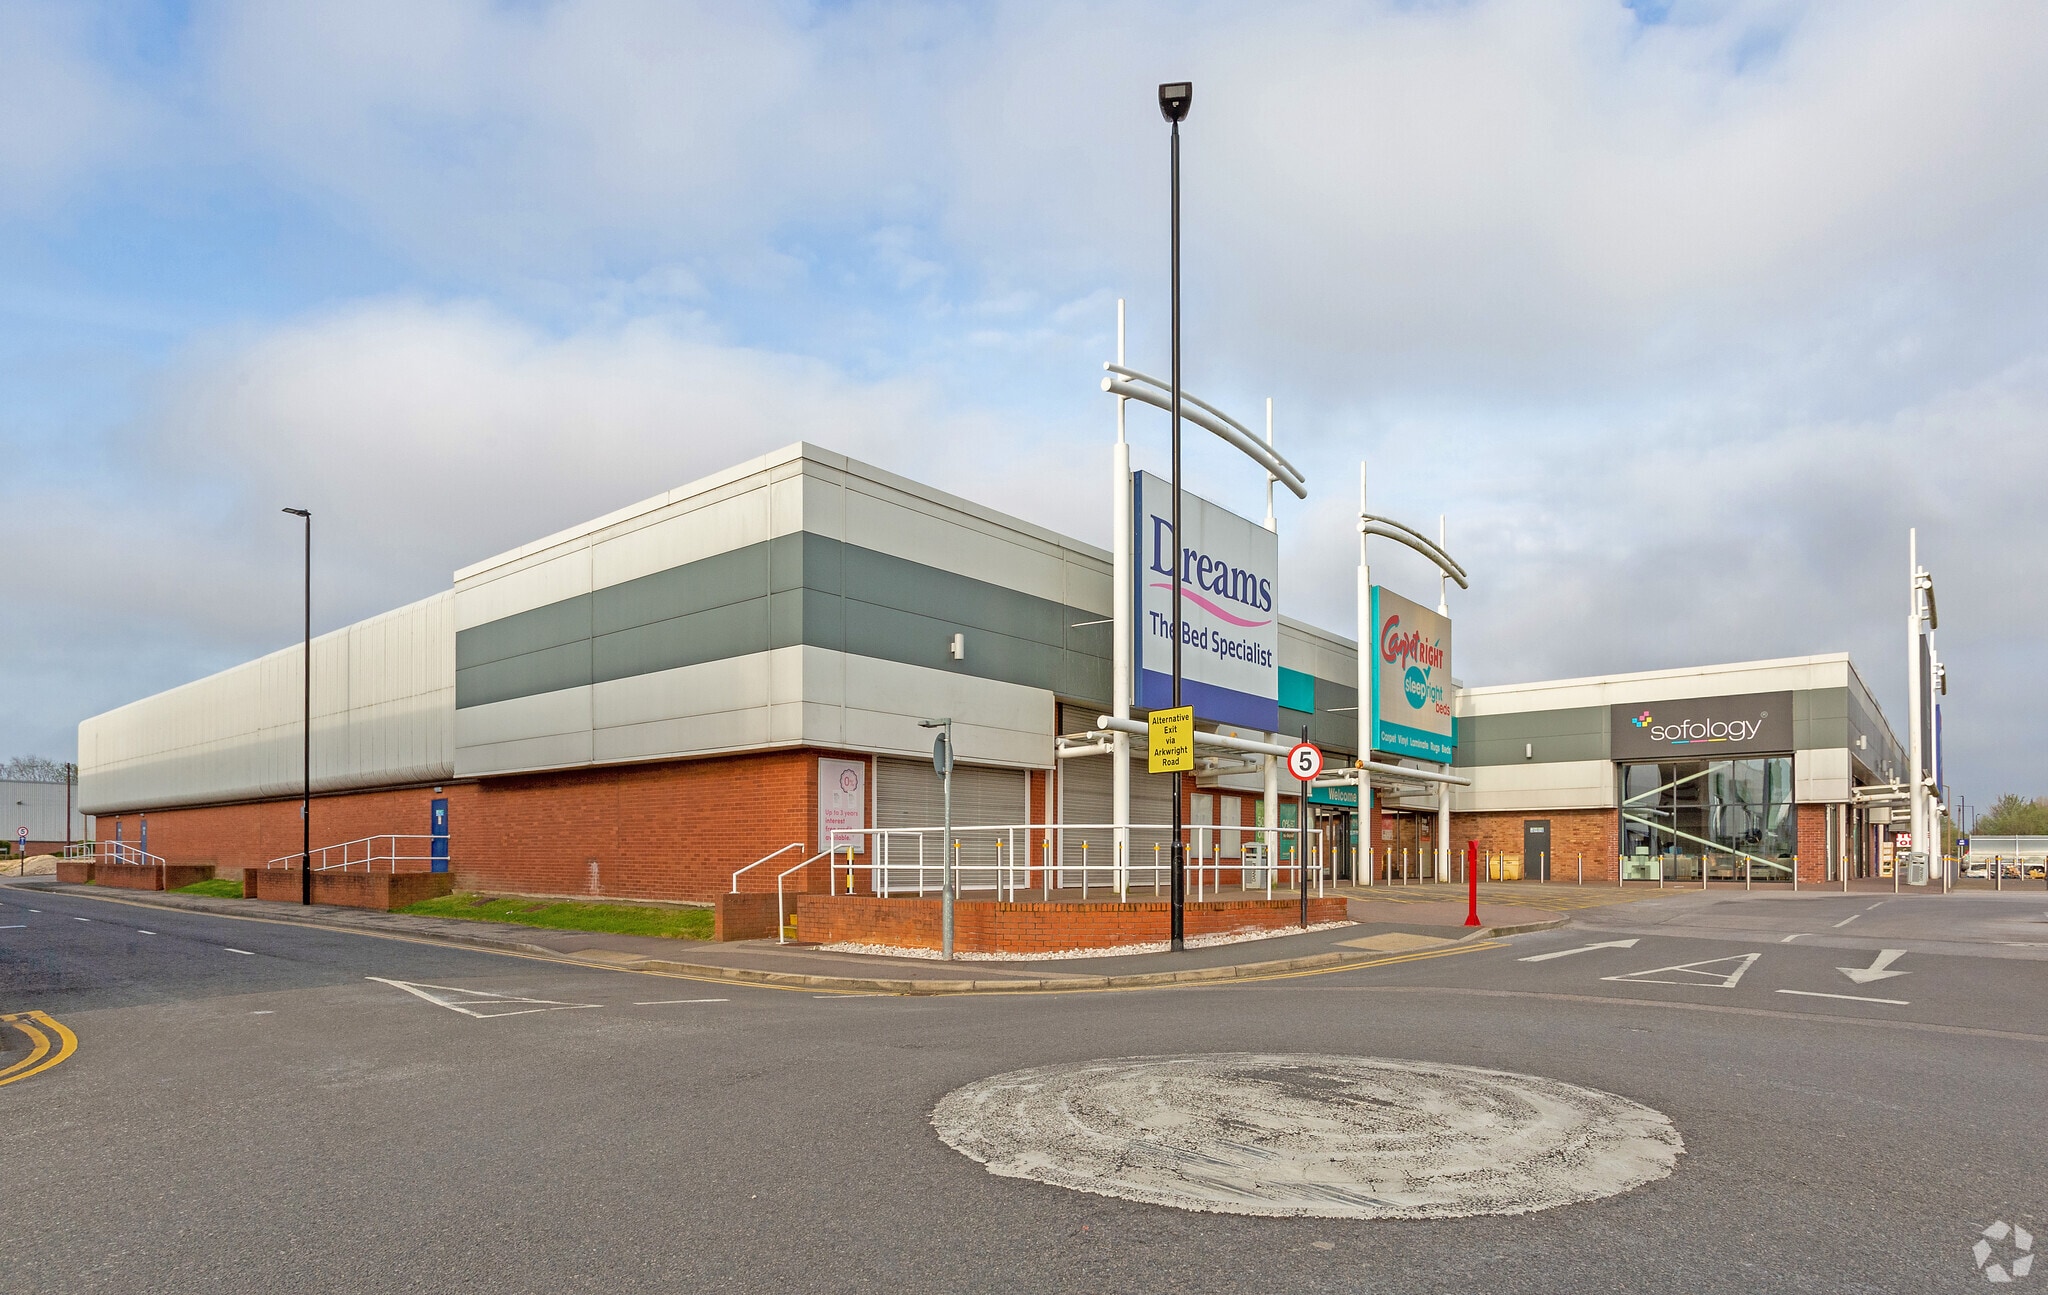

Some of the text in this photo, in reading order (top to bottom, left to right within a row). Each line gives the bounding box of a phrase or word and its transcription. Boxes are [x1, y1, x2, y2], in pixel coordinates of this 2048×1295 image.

[1150, 514, 1271, 613] Dreams
[1150, 610, 1272, 668] The Bed Specialist
[1381, 614, 1420, 671] Carpet
[1435, 701, 1450, 716] beds
[1152, 714, 1190, 725] Alternative
[1164, 725, 1177, 734] Exit
[1650, 718, 1762, 742] sofology
[1165, 736, 1176, 744] via
[1154, 746, 1188, 757] Arkwright
[1162, 757, 1180, 767] Road
[1300, 752, 1312, 771] 5
[1329, 788, 1357, 802] Welcome
